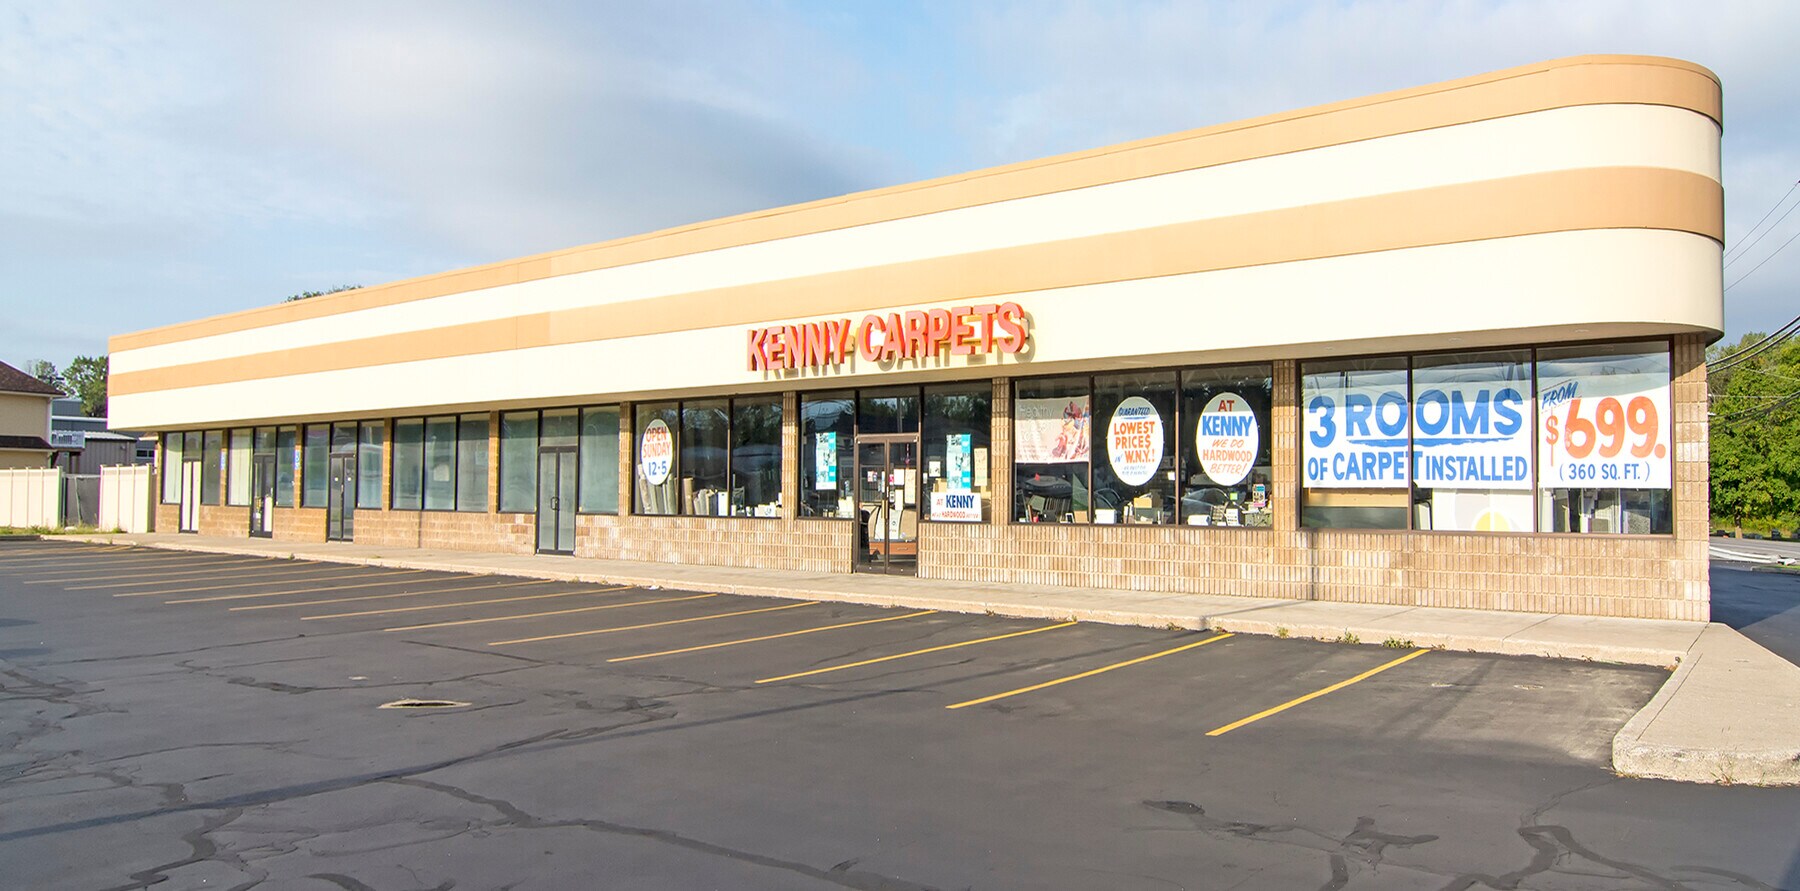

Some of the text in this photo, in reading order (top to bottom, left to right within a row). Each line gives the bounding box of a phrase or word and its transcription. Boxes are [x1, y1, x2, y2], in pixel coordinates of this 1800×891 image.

[747, 301, 1026, 372] KENNY CARPETS
[1541, 381, 1579, 411] FROM
[1217, 399, 1235, 412] AT
[1202, 414, 1254, 437] KENNY
[1308, 387, 1524, 448] 3 ROOMS
[645, 426, 668, 443] OPEN
[1113, 421, 1156, 436] LOWEST
[642, 440, 672, 459] SUNDAY
[1212, 438, 1245, 449] WE DO
[1202, 449, 1253, 463] HARDWOOD
[648, 460, 668, 477] 12-5
[1209, 462, 1248, 477] BETTER!
[1307, 450, 1529, 482] OF CARPET INSTALLED
[1601, 463, 1621, 481] SQ.
[936, 495, 974, 508] AT KENNY
